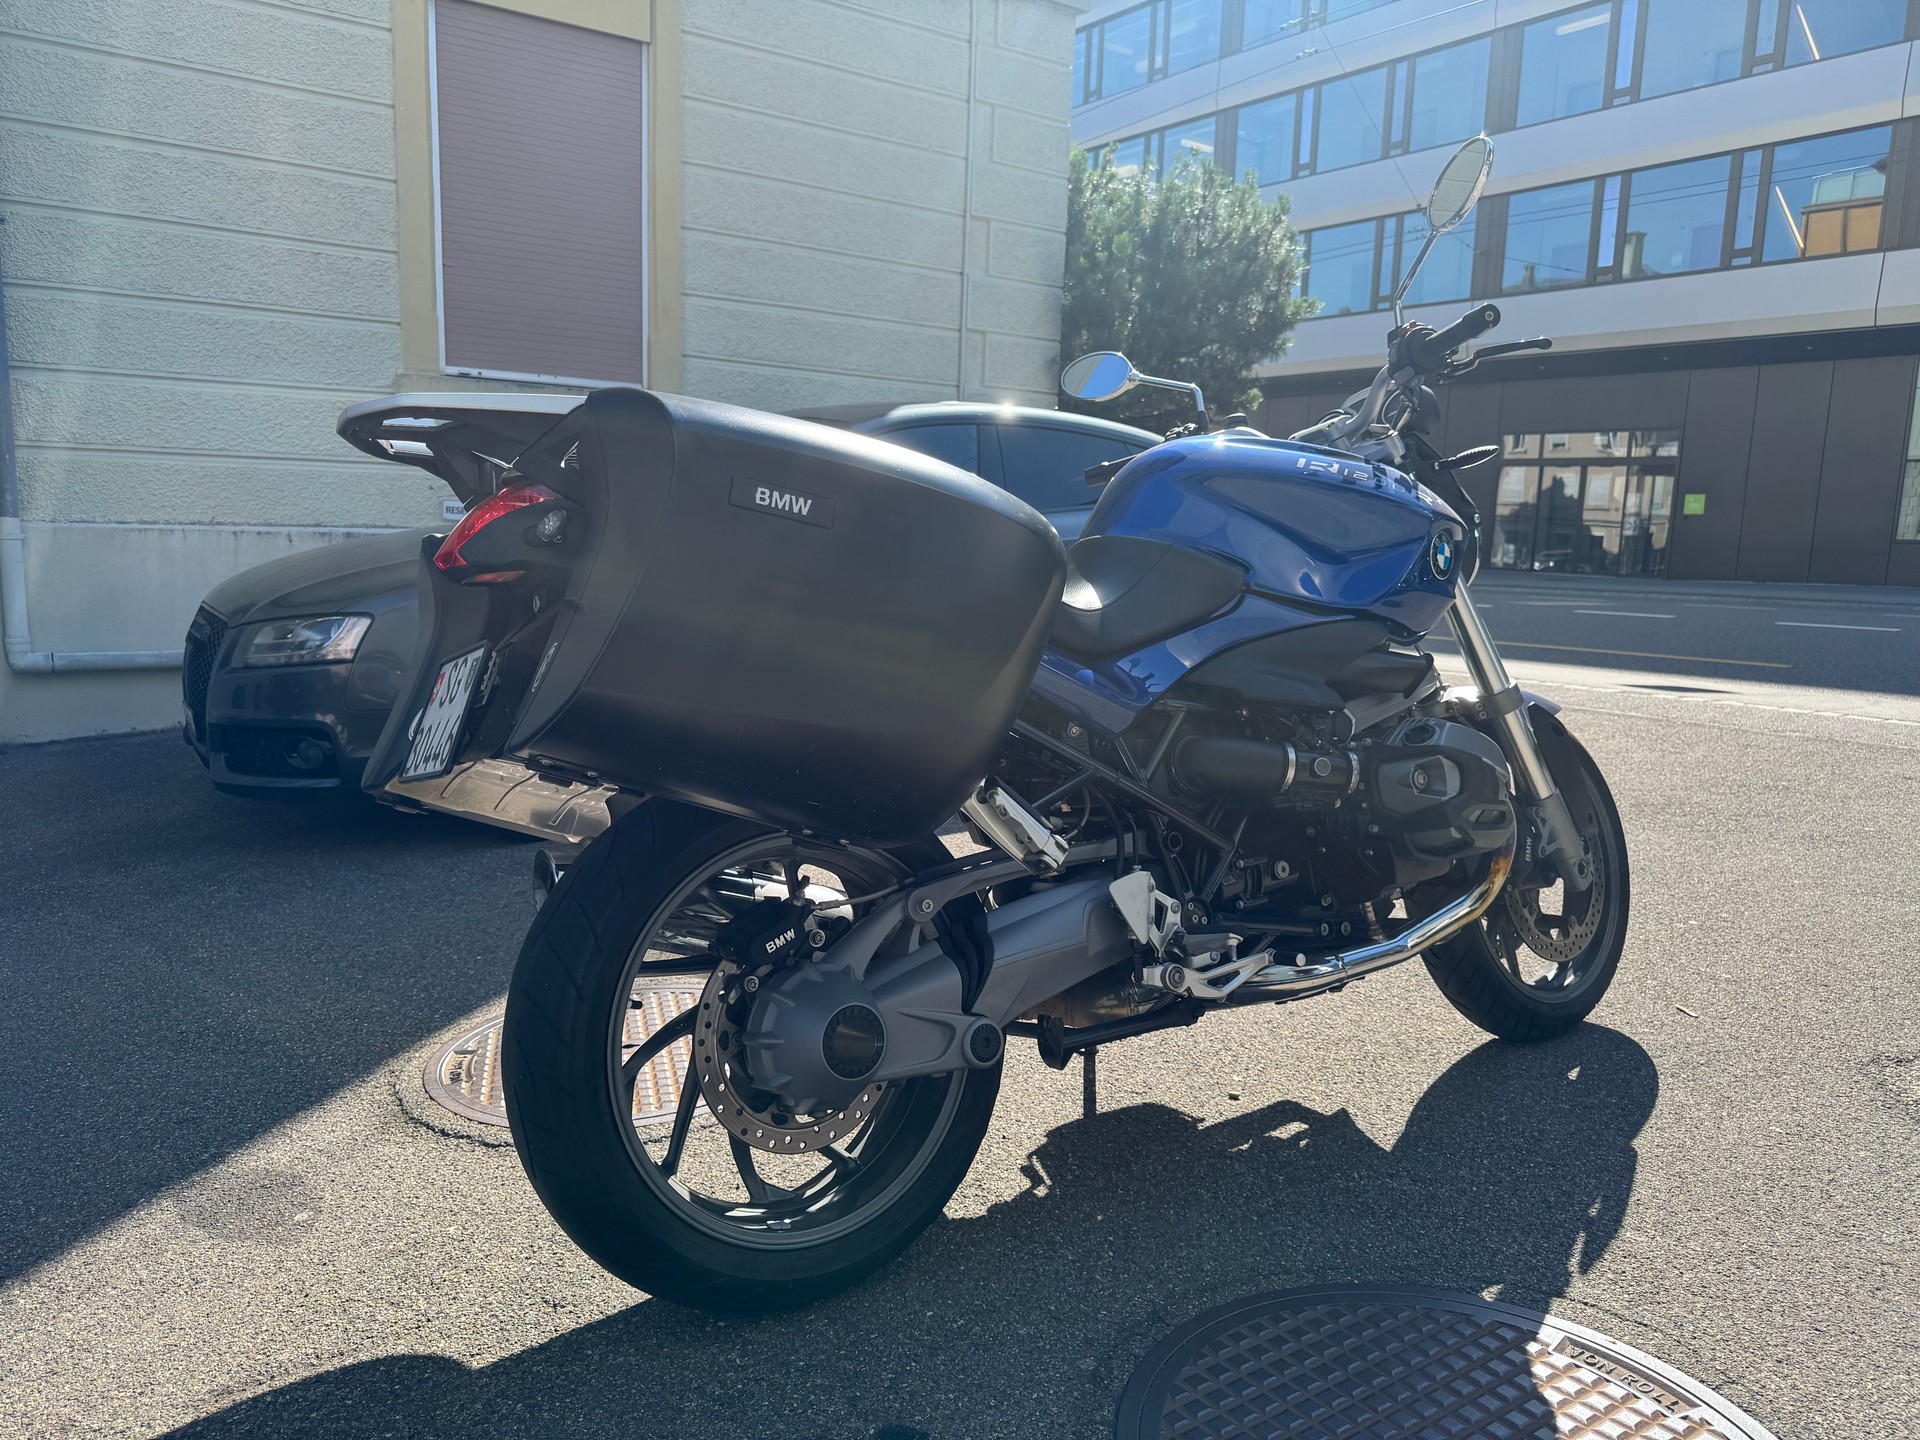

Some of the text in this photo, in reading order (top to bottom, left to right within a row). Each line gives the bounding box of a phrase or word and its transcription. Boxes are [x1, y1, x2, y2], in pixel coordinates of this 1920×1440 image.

[755, 486, 812, 516] BMW
[439, 656, 469, 709] SG
[403, 713, 461, 776] 30446
[765, 928, 796, 954] BMW
